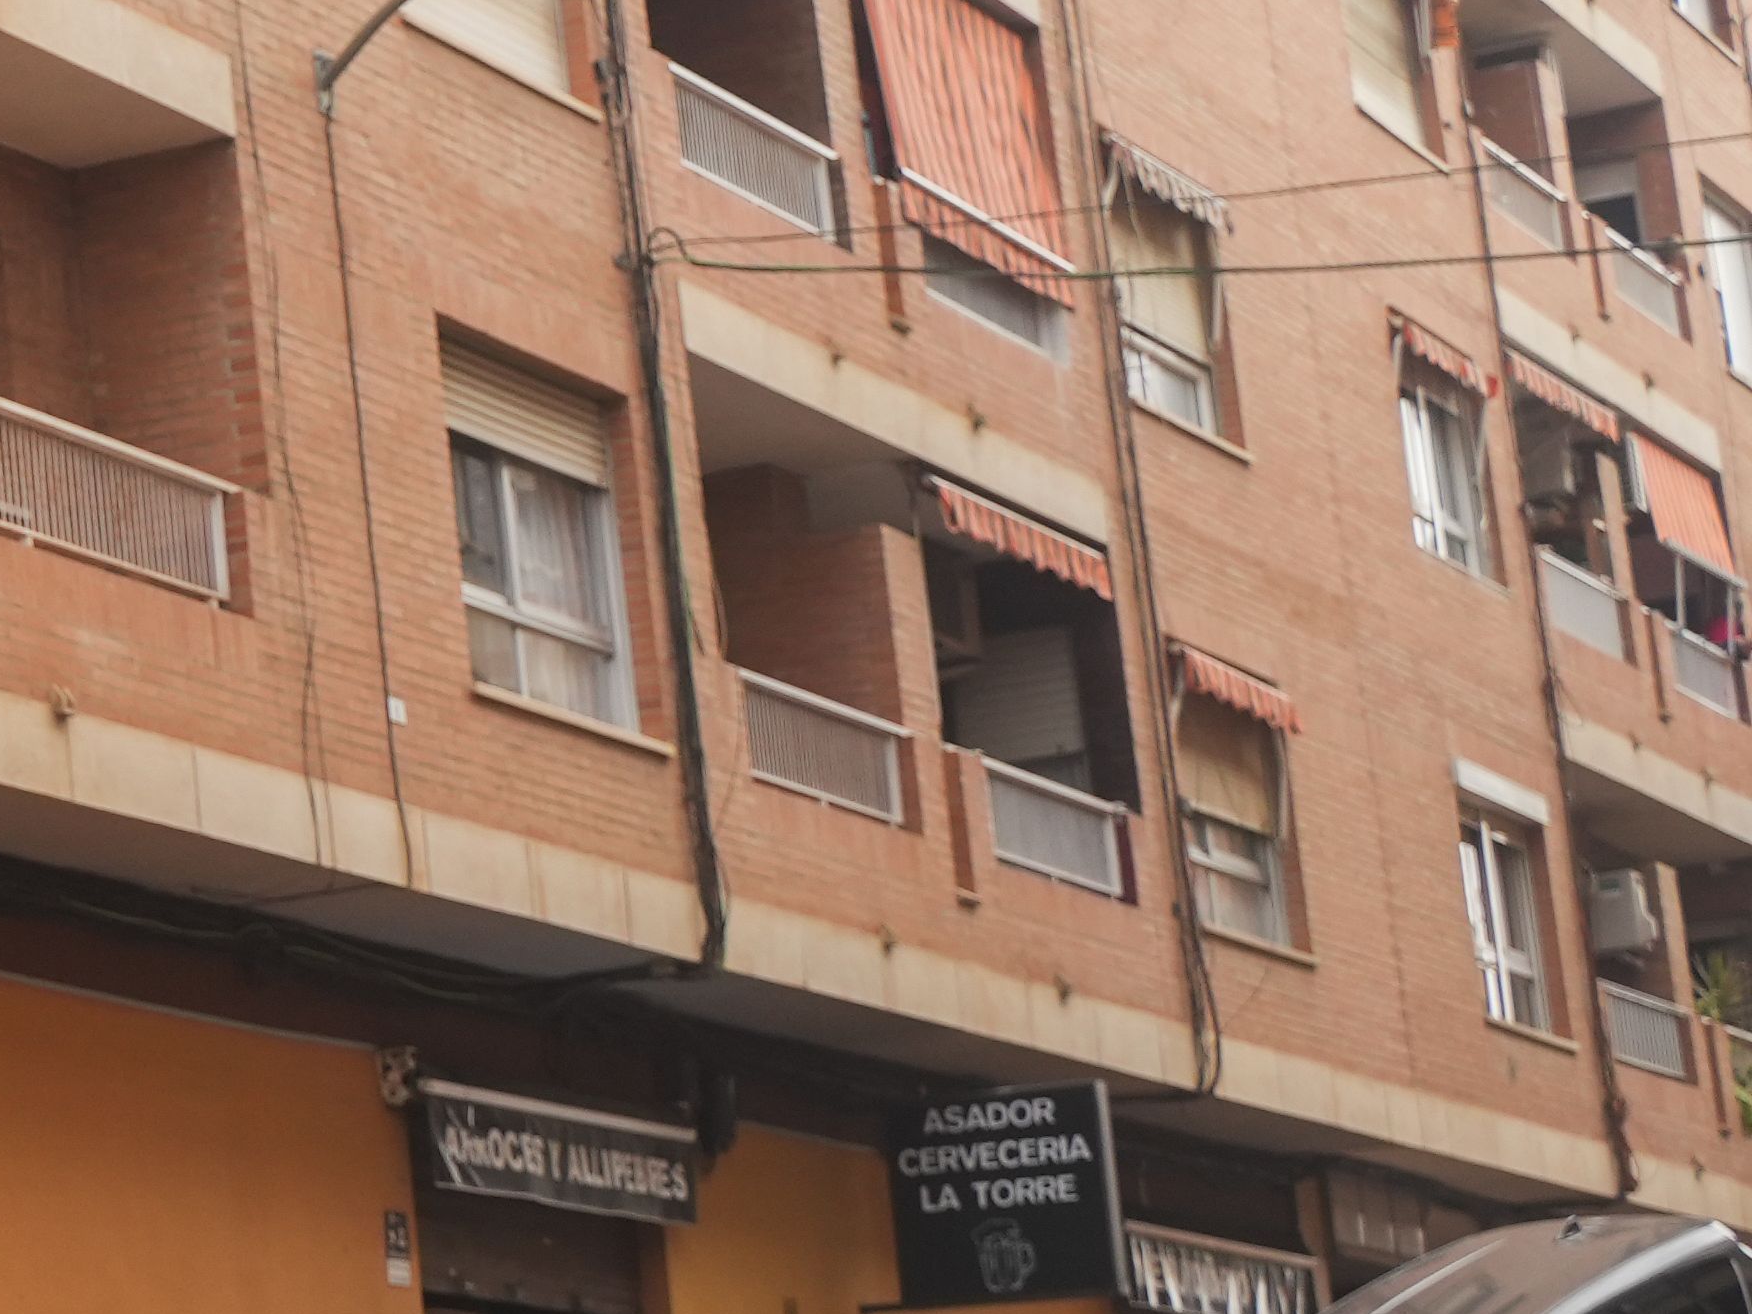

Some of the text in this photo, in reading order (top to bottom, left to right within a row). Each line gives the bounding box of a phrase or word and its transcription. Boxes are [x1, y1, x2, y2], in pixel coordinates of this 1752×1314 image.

[923, 1096, 1057, 1135] ASADOR
[898, 1132, 1094, 1178] CERVECERIA
[919, 1172, 1081, 1214] LA TORRE
